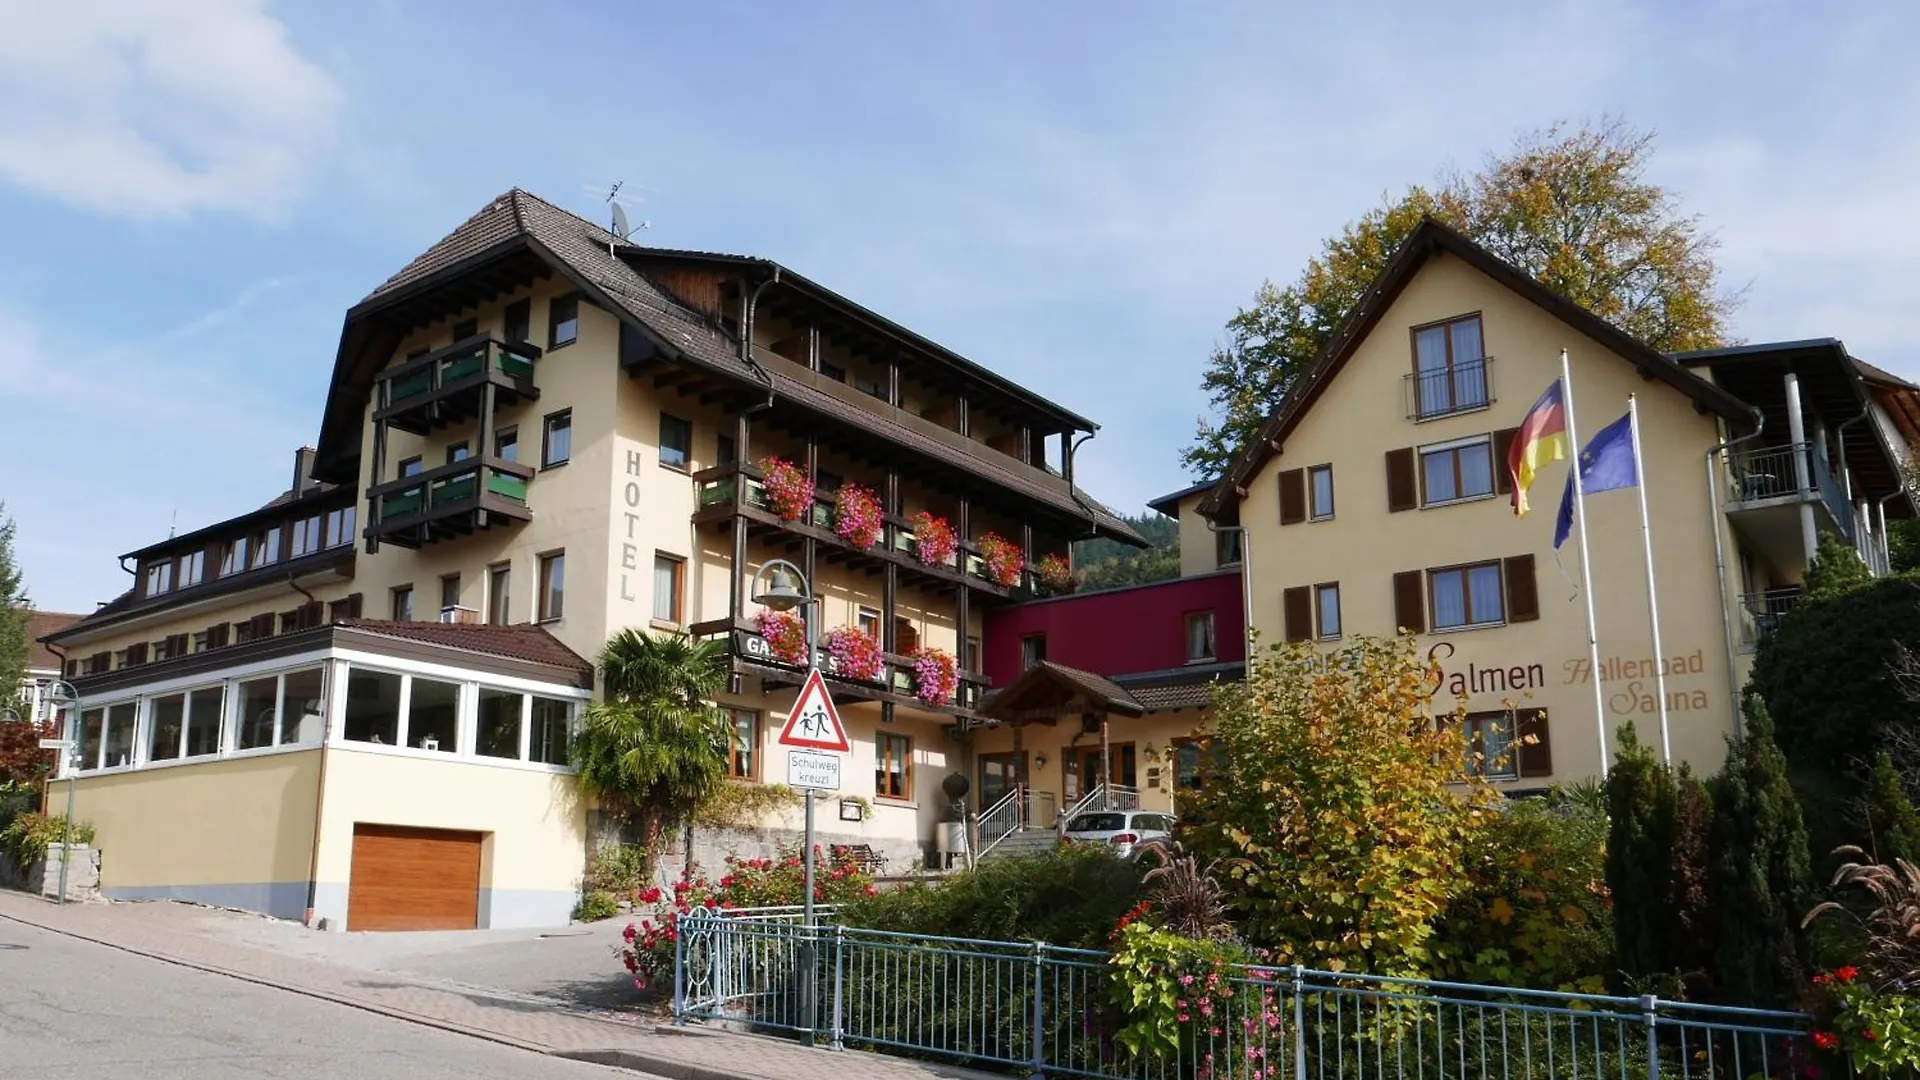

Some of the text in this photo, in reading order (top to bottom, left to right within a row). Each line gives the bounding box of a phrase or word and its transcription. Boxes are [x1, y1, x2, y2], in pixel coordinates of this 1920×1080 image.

[619, 450, 642, 602] HOTEL
[1411, 641, 1545, 699] Salmen
[1562, 648, 1706, 685] Hallenbad
[1608, 680, 1709, 716] Sauna
[791, 755, 838, 774] Schulweg
